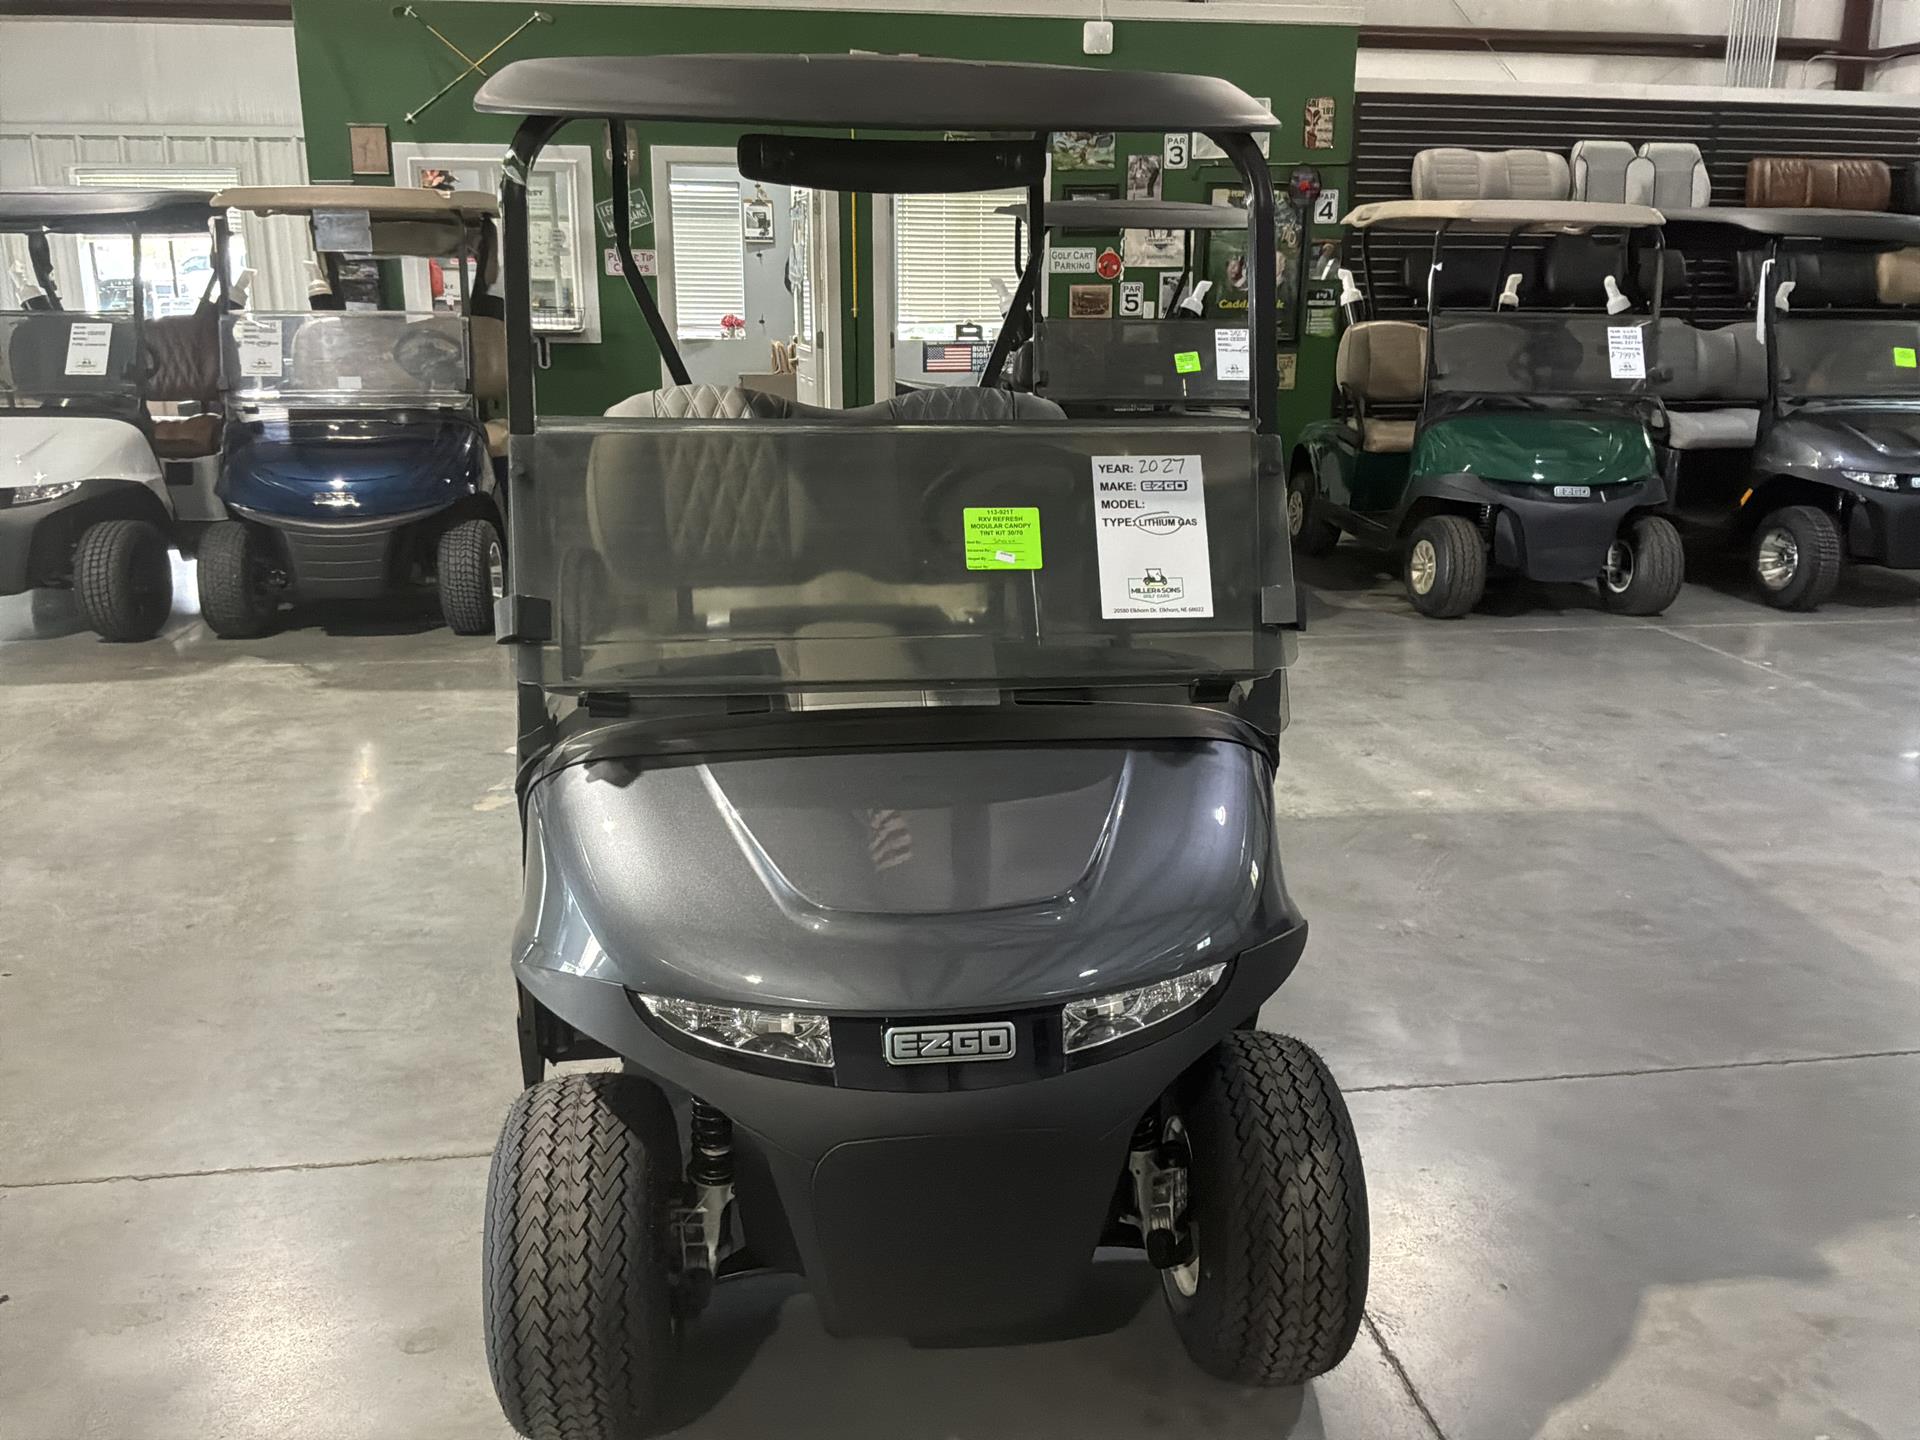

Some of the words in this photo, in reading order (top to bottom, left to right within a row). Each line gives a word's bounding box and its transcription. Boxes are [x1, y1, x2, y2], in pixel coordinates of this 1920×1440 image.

[1169, 146, 1183, 165] 3
[1319, 201, 1333, 220] 4
[1052, 251, 1072, 260] GOLF
[1073, 251, 1093, 260] CART
[1054, 261, 1090, 270] PARKING
[1124, 294, 1139, 312] 5
[1098, 464, 1133, 473] YEAR:
[1138, 458, 1186, 475] 2027
[1100, 482, 1136, 491] MAKE:
[1101, 500, 1145, 509] MODEL:
[1102, 518, 1136, 527] TYPE:
[1138, 518, 1175, 527] LITHIUM
[1178, 518, 1198, 526] GAS
